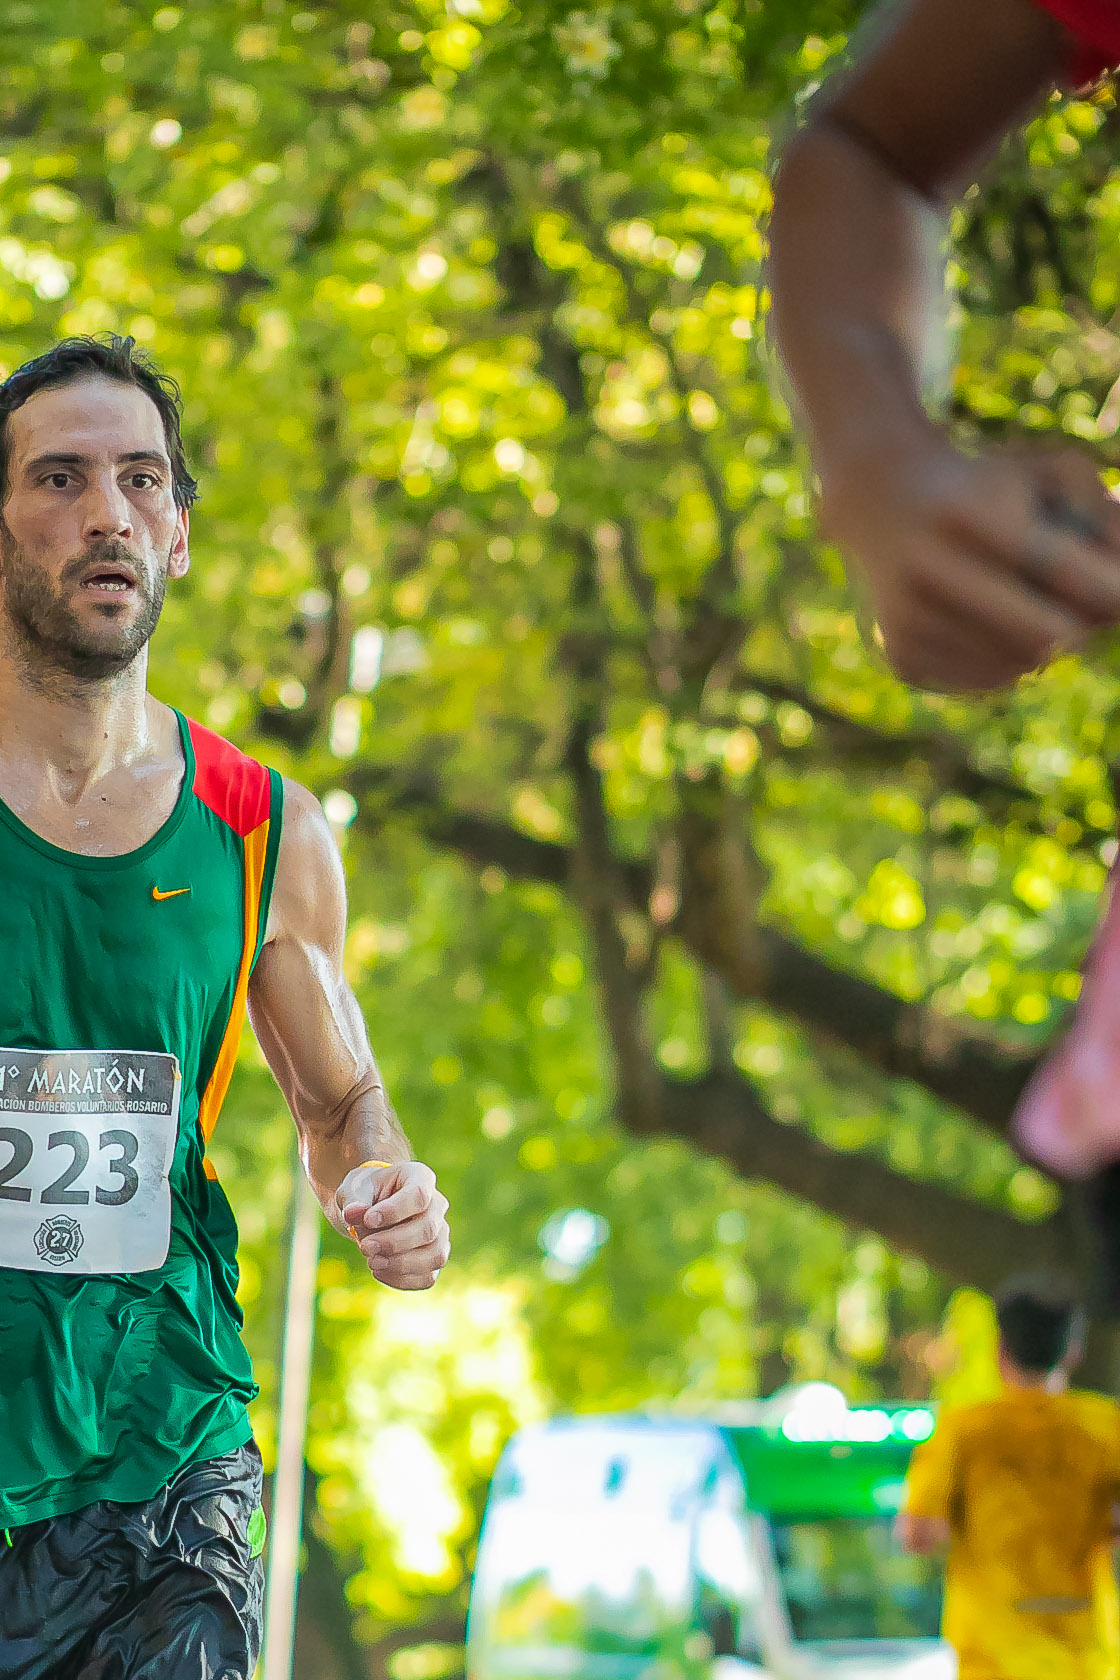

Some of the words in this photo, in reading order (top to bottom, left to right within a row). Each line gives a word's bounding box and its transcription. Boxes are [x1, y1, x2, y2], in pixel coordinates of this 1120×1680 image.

[27, 1059, 146, 1094] MARATÓN
[27, 1101, 75, 1113] BOMBEROS
[76, 1100, 125, 1113] VOLUNTARIOS
[126, 1100, 168, 1114] ROSARIO
[50, 1230, 71, 1248] 27
